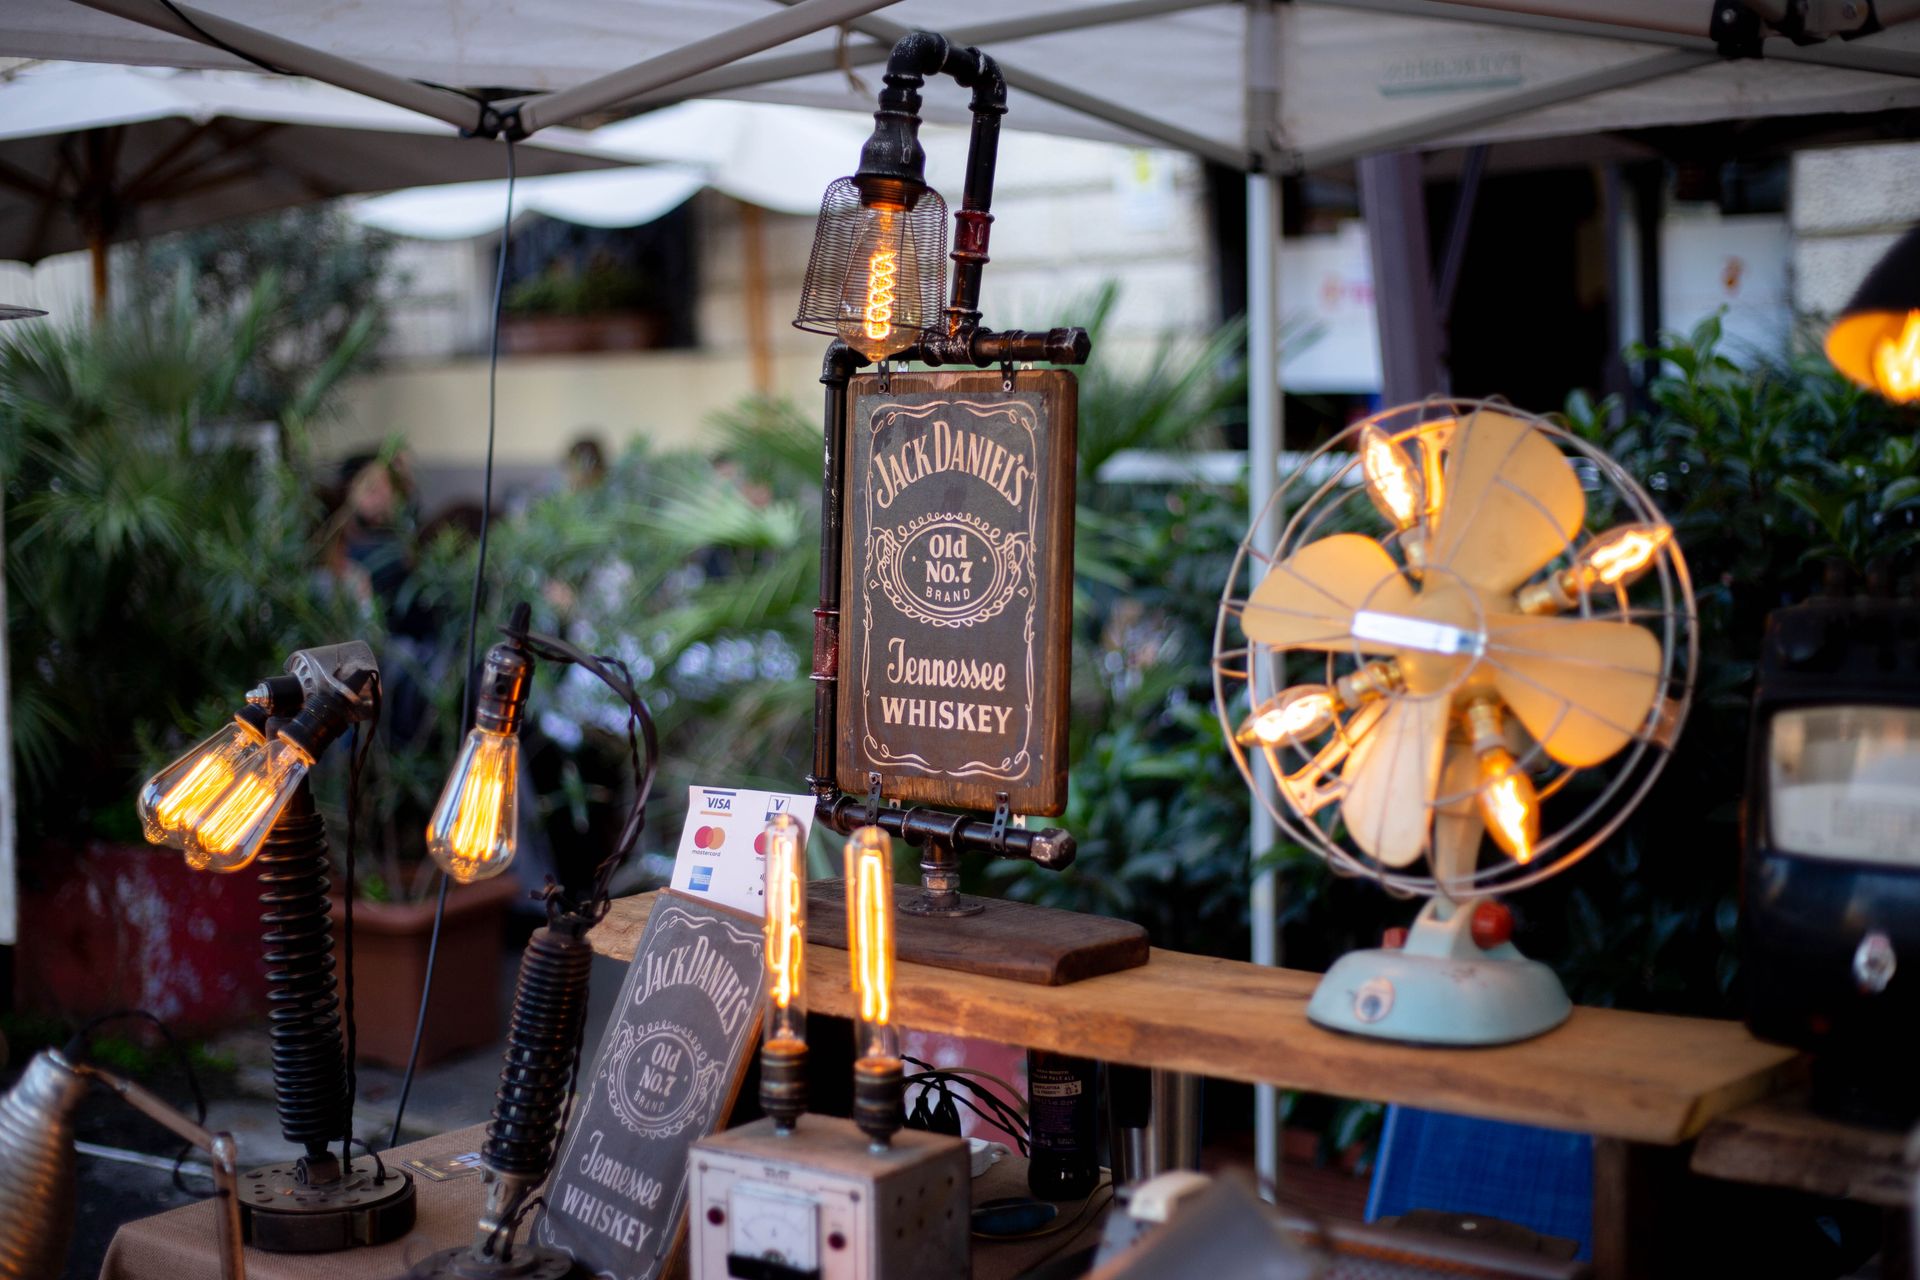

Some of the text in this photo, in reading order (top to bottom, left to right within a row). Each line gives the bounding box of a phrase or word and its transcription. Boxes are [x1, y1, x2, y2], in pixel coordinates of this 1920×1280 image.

[873, 419, 1032, 509] JACK DANIEL'S
[929, 534, 968, 560] Old
[926, 586, 971, 603] BRAND
[887, 637, 1006, 692] Tennessee
[880, 696, 1013, 735] WHISKEY
[707, 797, 731, 810] VISA
[692, 849, 721, 857] mastercard
[635, 935, 750, 1035] JACK DANIEL'S
[651, 1041, 682, 1073] Old
[633, 1089, 665, 1114] BRAND
[579, 1130, 663, 1210] Tennessee
[561, 1183, 653, 1253] WHISKEY
